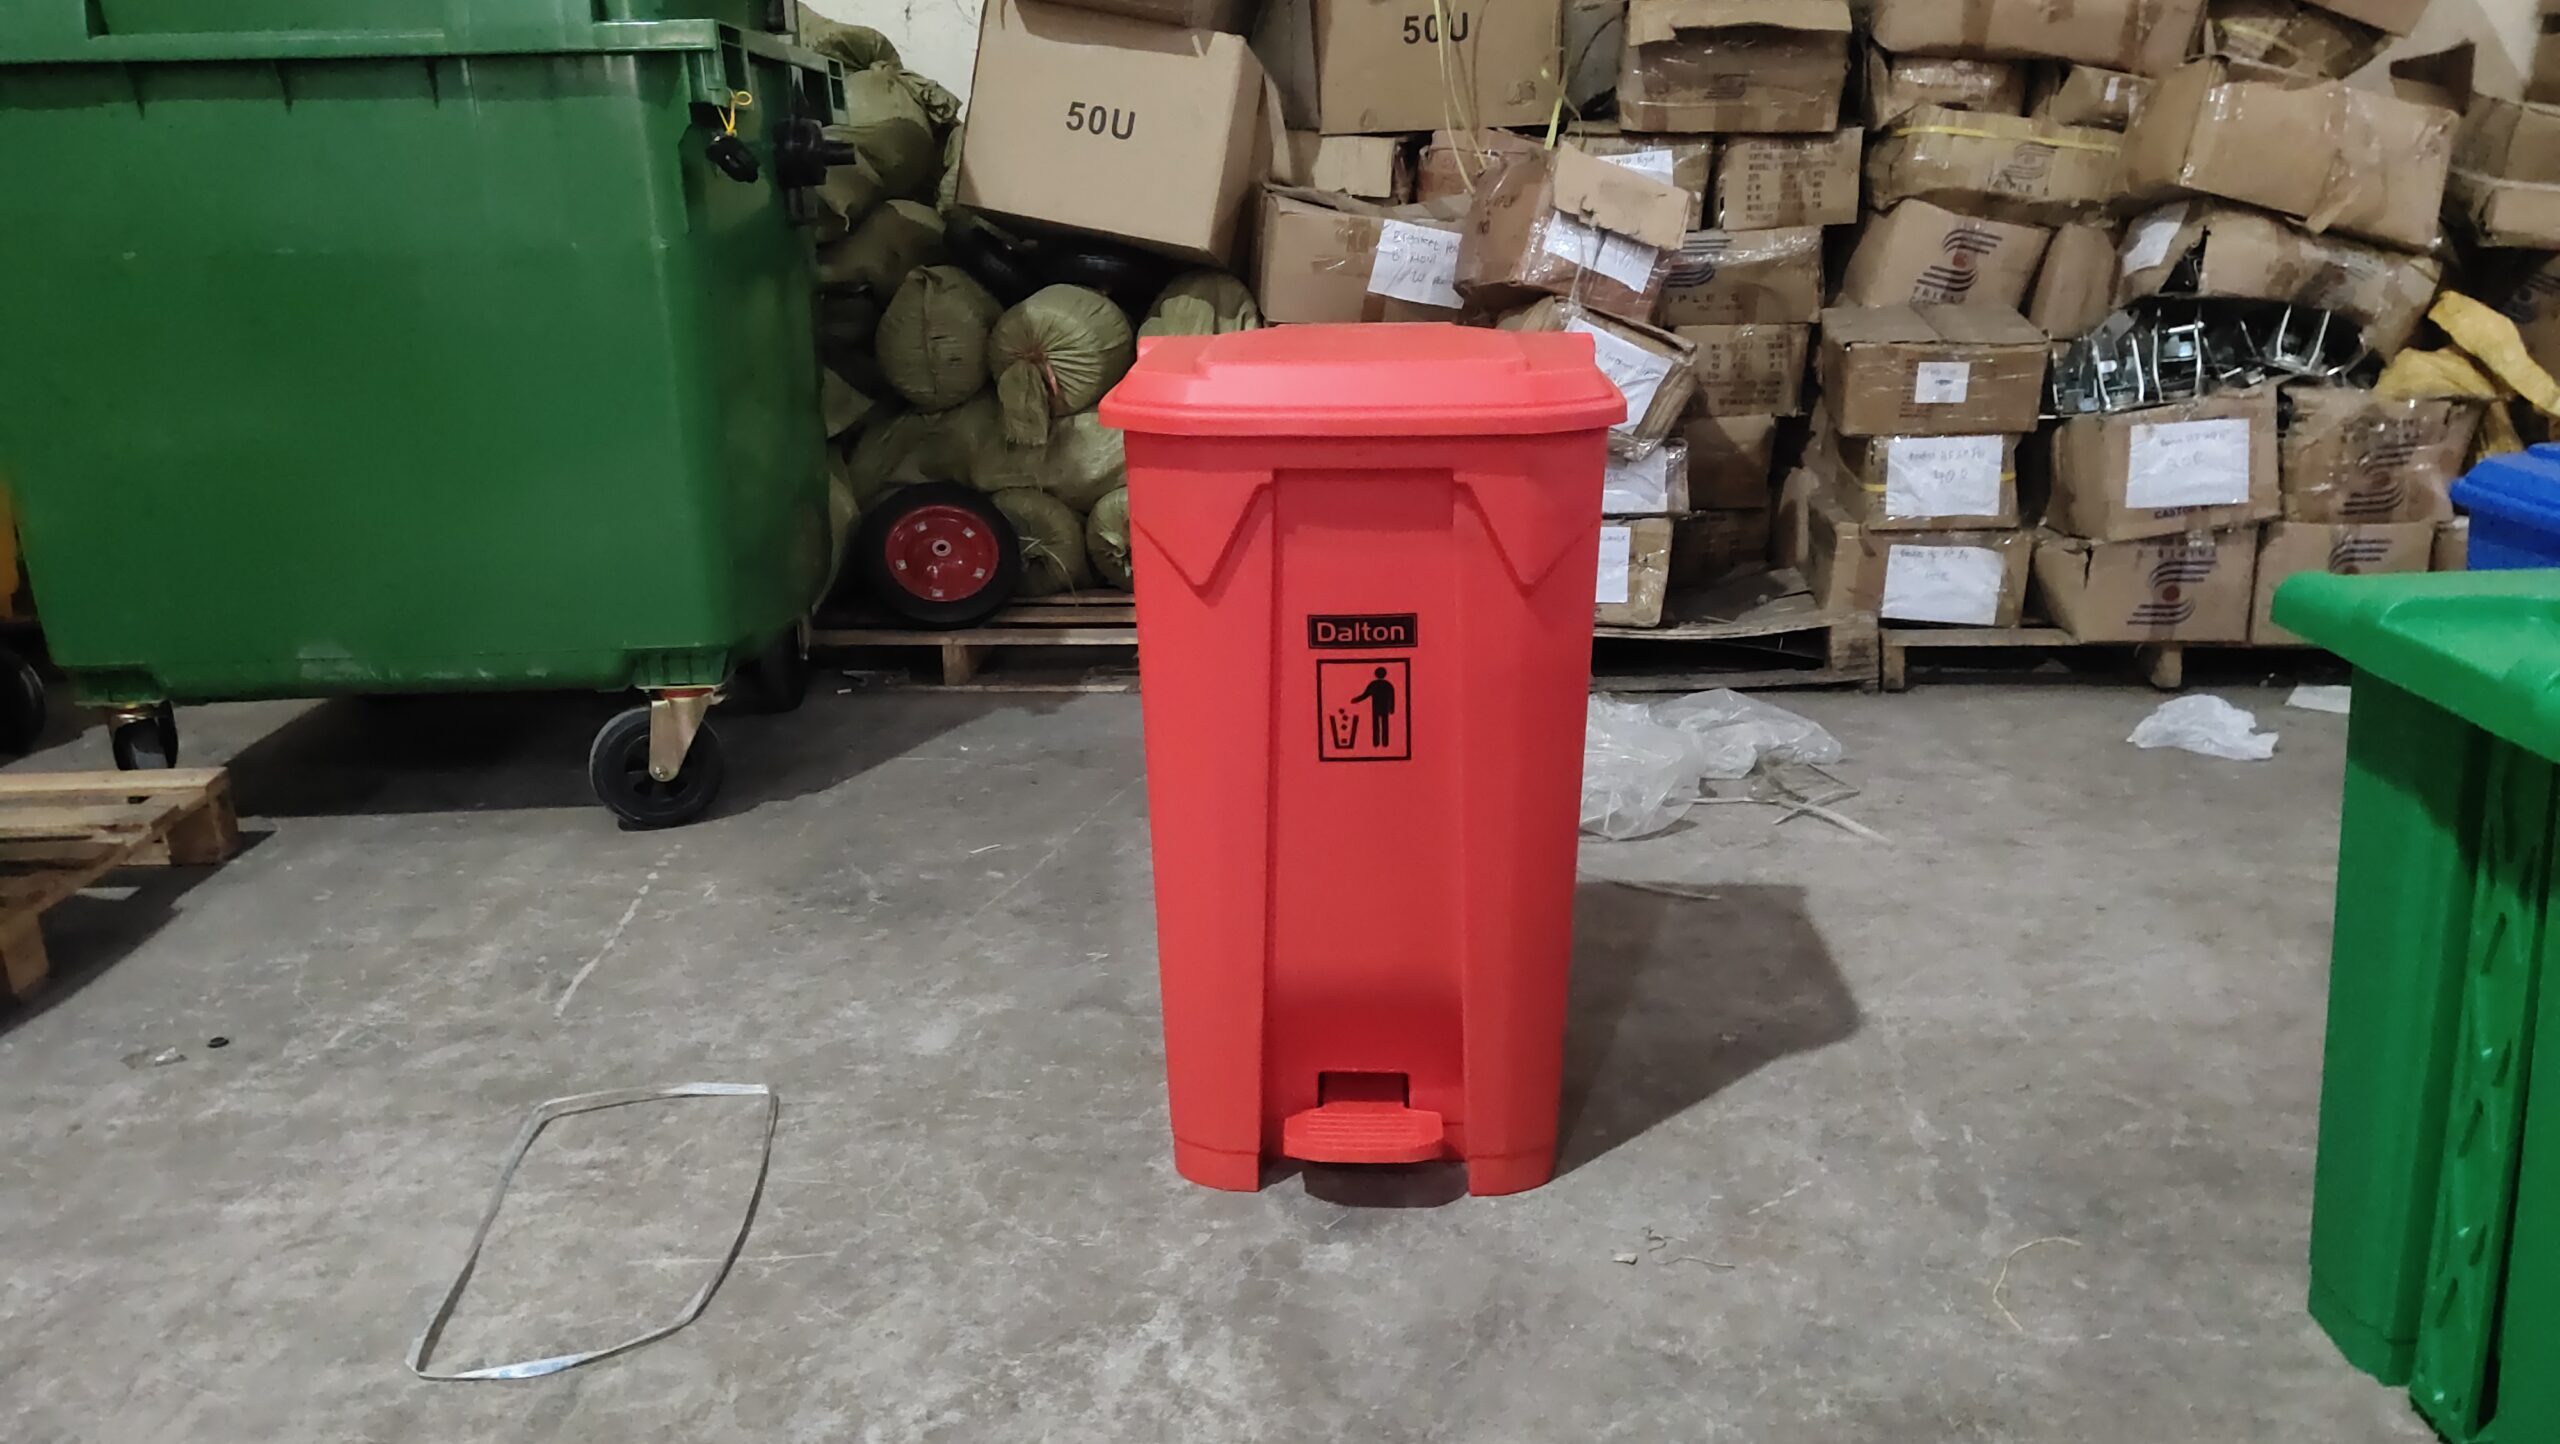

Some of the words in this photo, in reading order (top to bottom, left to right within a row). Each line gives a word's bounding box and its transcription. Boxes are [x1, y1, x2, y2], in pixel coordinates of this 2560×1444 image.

[1403, 12, 1468, 45] 50U
[1066, 101, 1136, 140] 50U
[1316, 622, 1405, 642] Dalton
